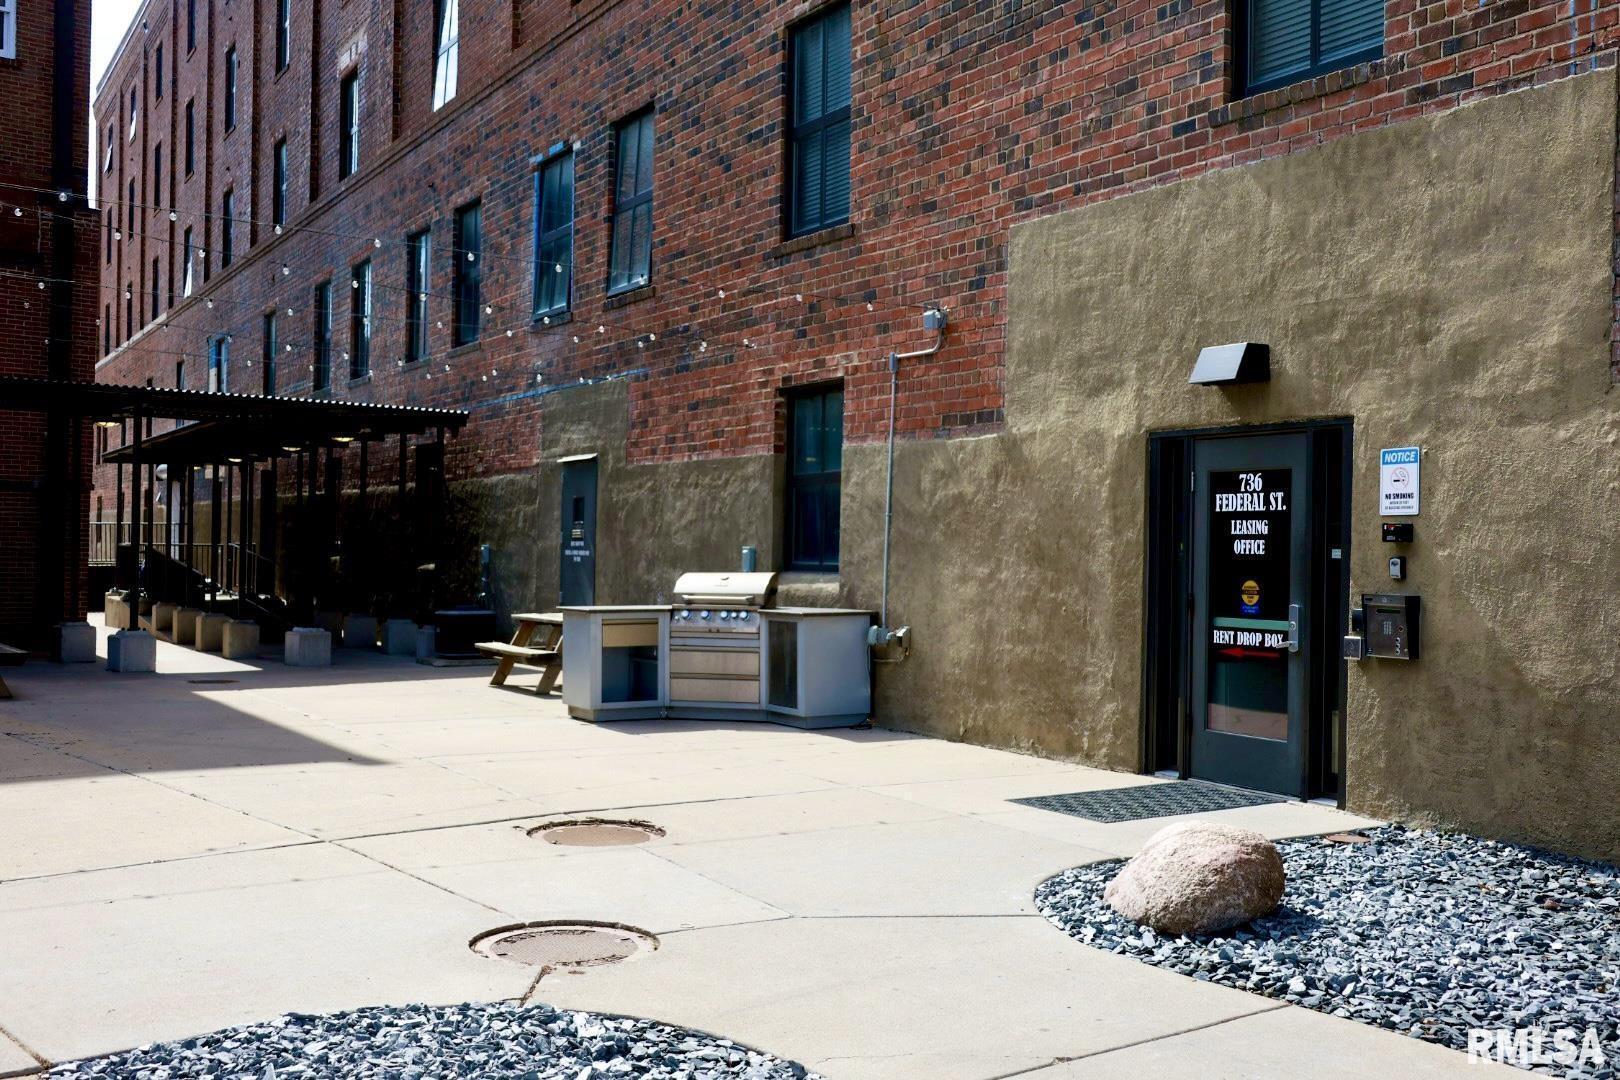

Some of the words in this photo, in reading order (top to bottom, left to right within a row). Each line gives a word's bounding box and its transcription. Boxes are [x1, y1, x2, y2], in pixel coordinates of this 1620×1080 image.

[1384, 451, 1416, 463] NOTICE
[1239, 473, 1262, 491] 736
[1215, 492, 1266, 512] FEDERAL
[1269, 492, 1287, 511] ST.
[1392, 492, 1414, 500] SMOKING
[1231, 520, 1269, 535] LEASING
[1233, 539, 1265, 555] OFFICE
[1213, 629, 1235, 645] RENT
[1236, 631, 1263, 647] DROP
